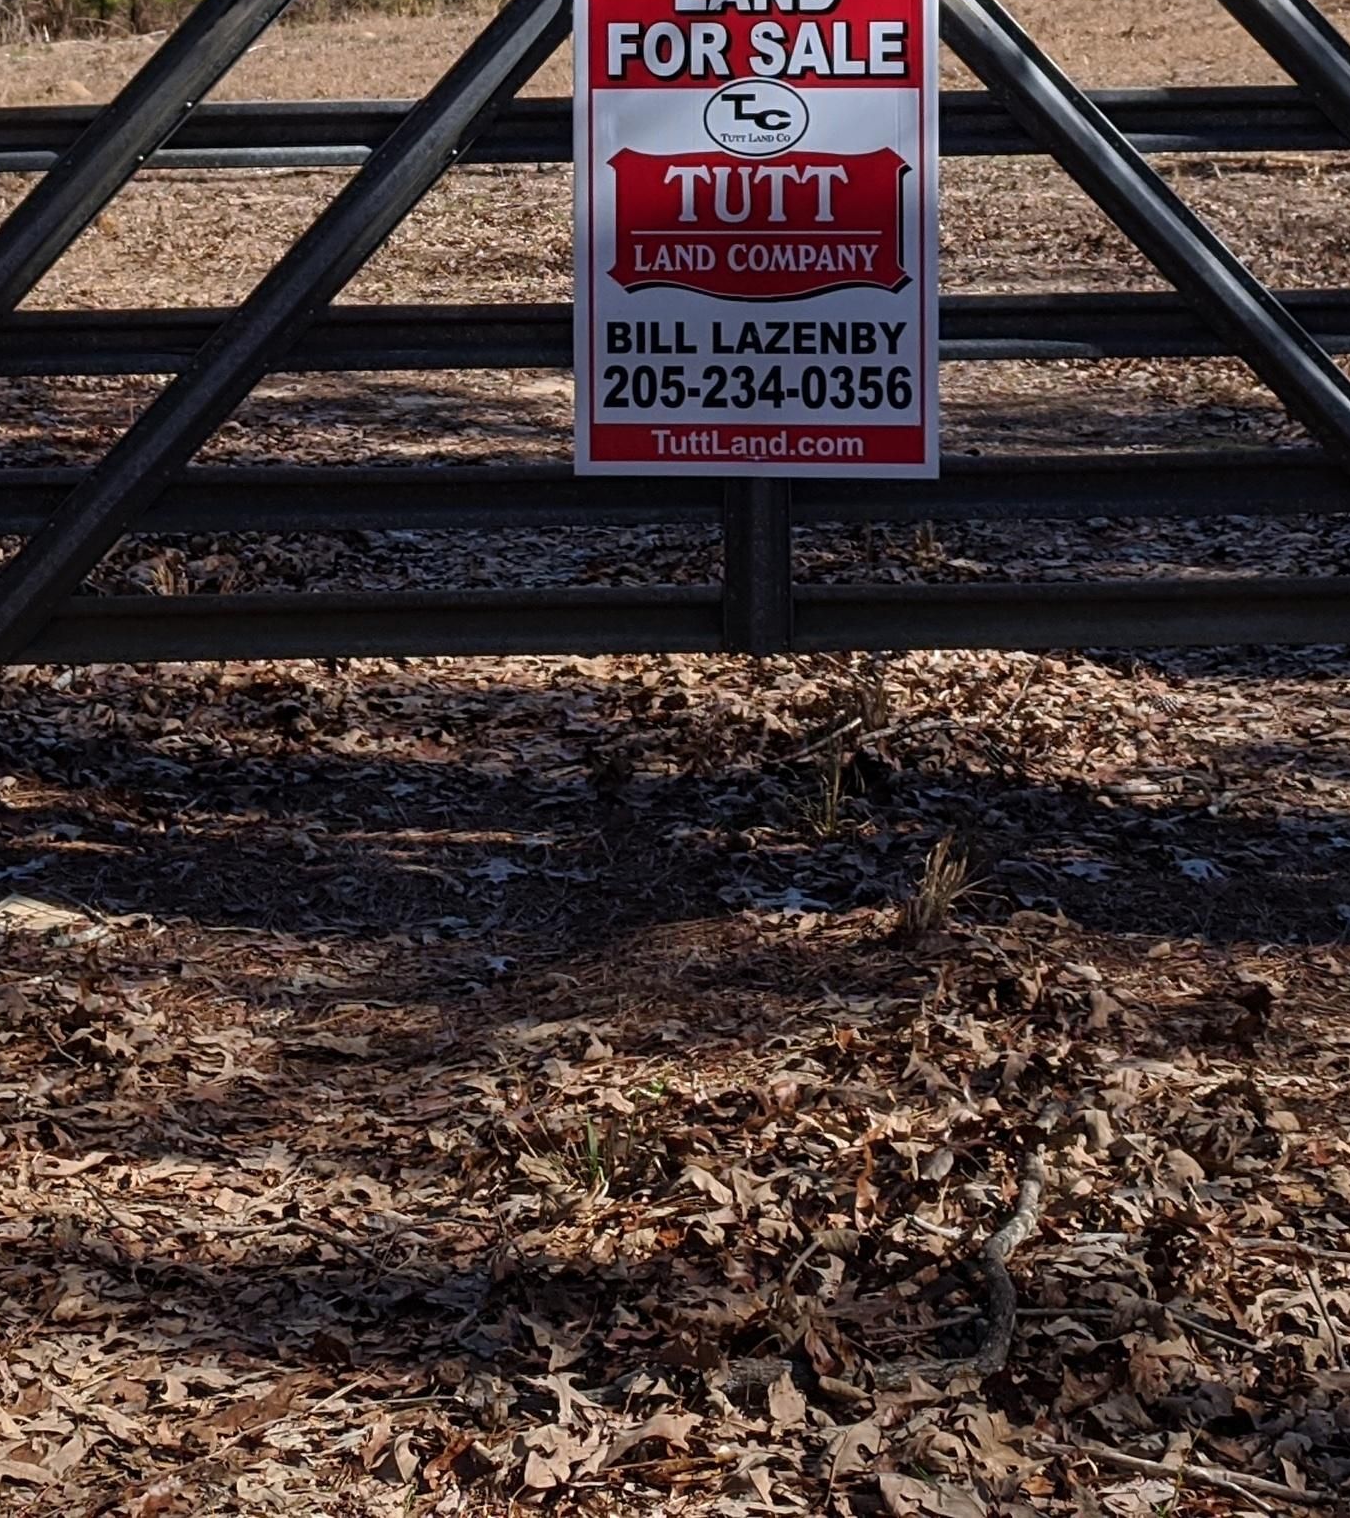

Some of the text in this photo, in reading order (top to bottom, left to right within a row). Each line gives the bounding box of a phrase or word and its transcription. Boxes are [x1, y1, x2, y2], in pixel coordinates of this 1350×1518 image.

[607, 20, 906, 77] FOR SALE
[664, 165, 849, 223] TUTT
[635, 243, 879, 272] LAND COMPANY
[606, 322, 907, 355] BILL LAZENBY
[603, 365, 913, 410] 205-234-0356
[651, 430, 865, 458] TuttLand.com
